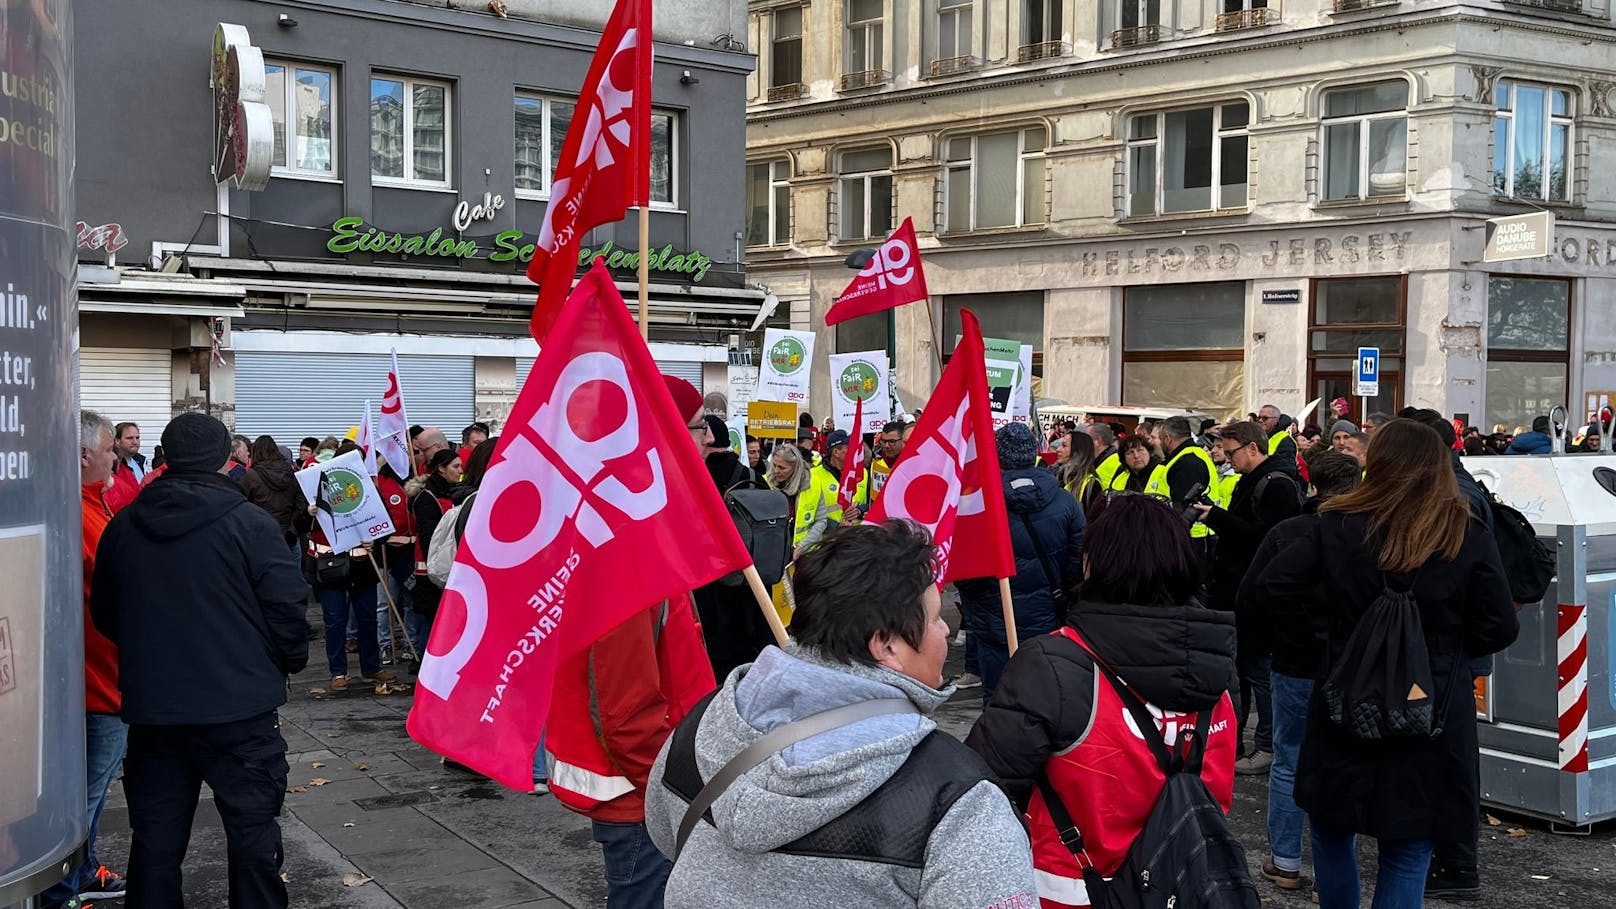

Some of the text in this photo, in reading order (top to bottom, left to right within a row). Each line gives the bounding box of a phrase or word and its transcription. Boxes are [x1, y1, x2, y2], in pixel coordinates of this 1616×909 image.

[0, 70, 55, 114] ustria
[1497, 222, 1527, 235] AUDIO
[327, 216, 478, 257] Eissalon
[1497, 231, 1537, 245] DANUBE
[1082, 231, 1413, 277] HELFORD JERSEY
[842, 373, 862, 382] FaiR
[787, 391, 804, 401] gpa
[990, 402, 1003, 410] NG
[0, 395, 25, 437] ld,
[1052, 414, 1080, 424] MACH
[869, 420, 888, 430] gpa
[368, 522, 389, 537] gpa
